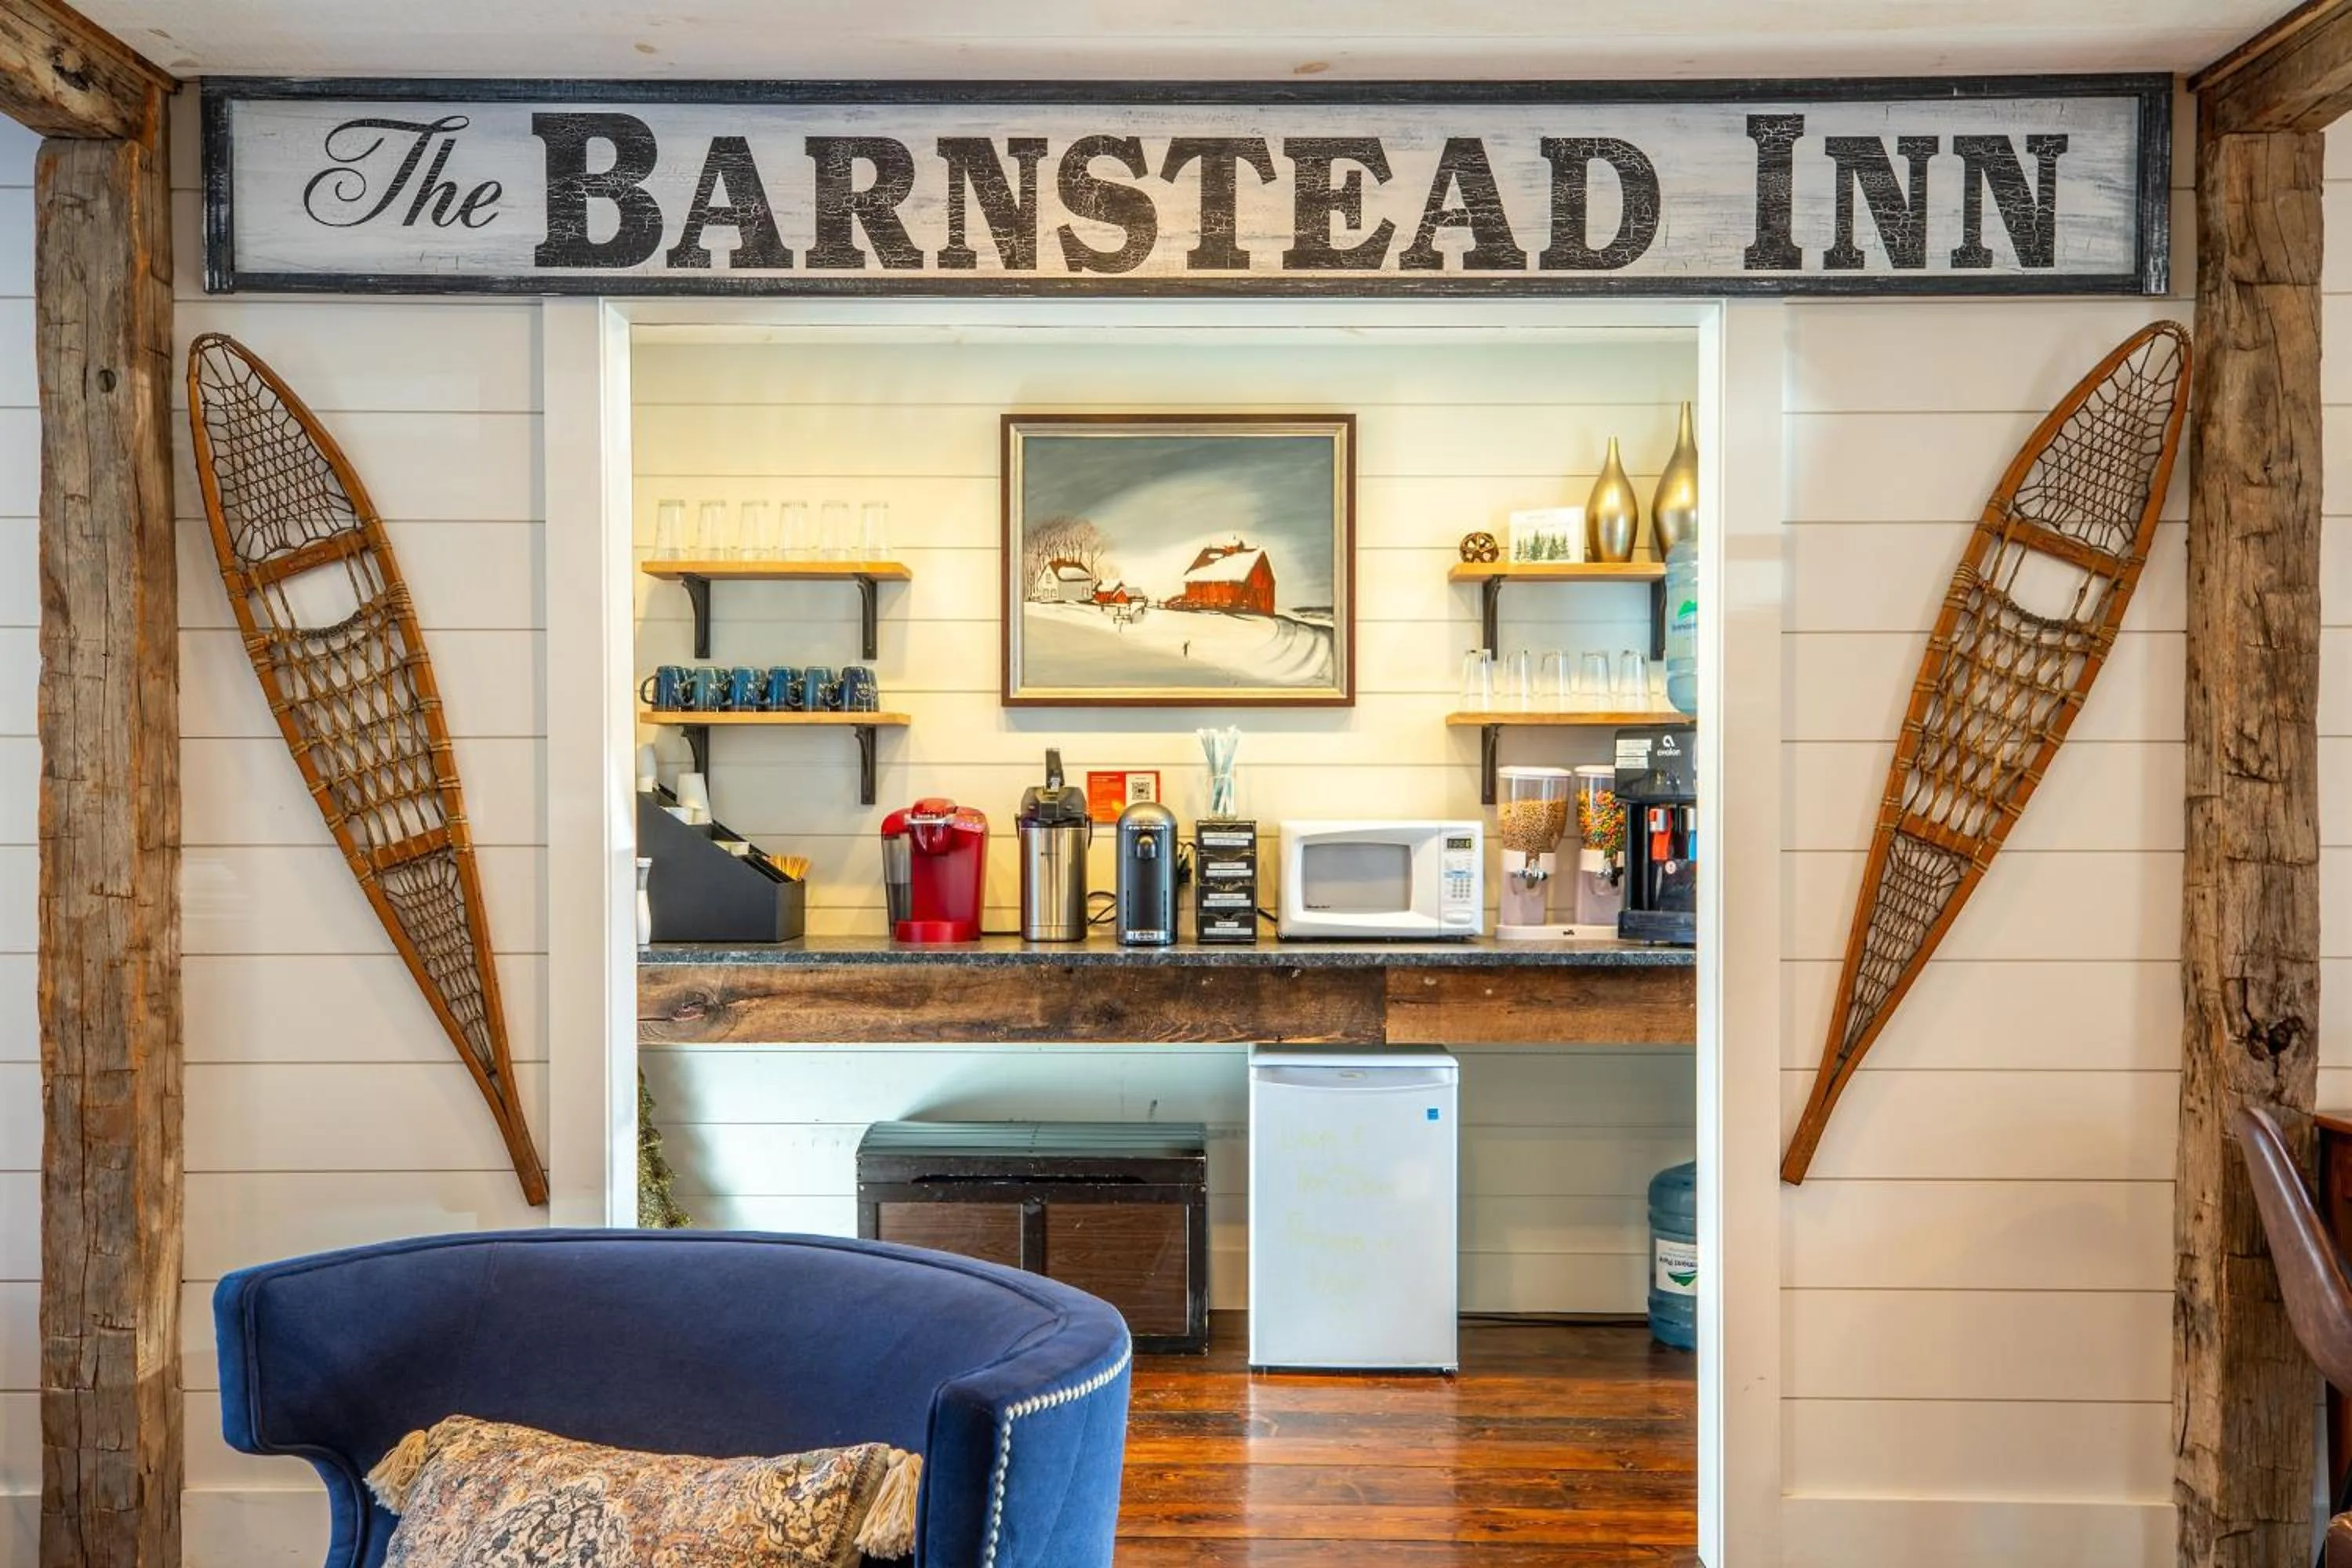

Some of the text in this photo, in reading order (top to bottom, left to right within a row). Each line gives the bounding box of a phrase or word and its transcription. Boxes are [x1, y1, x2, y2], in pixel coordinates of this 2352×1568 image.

[303, 112, 2069, 273] The BARNSTEAD INN
